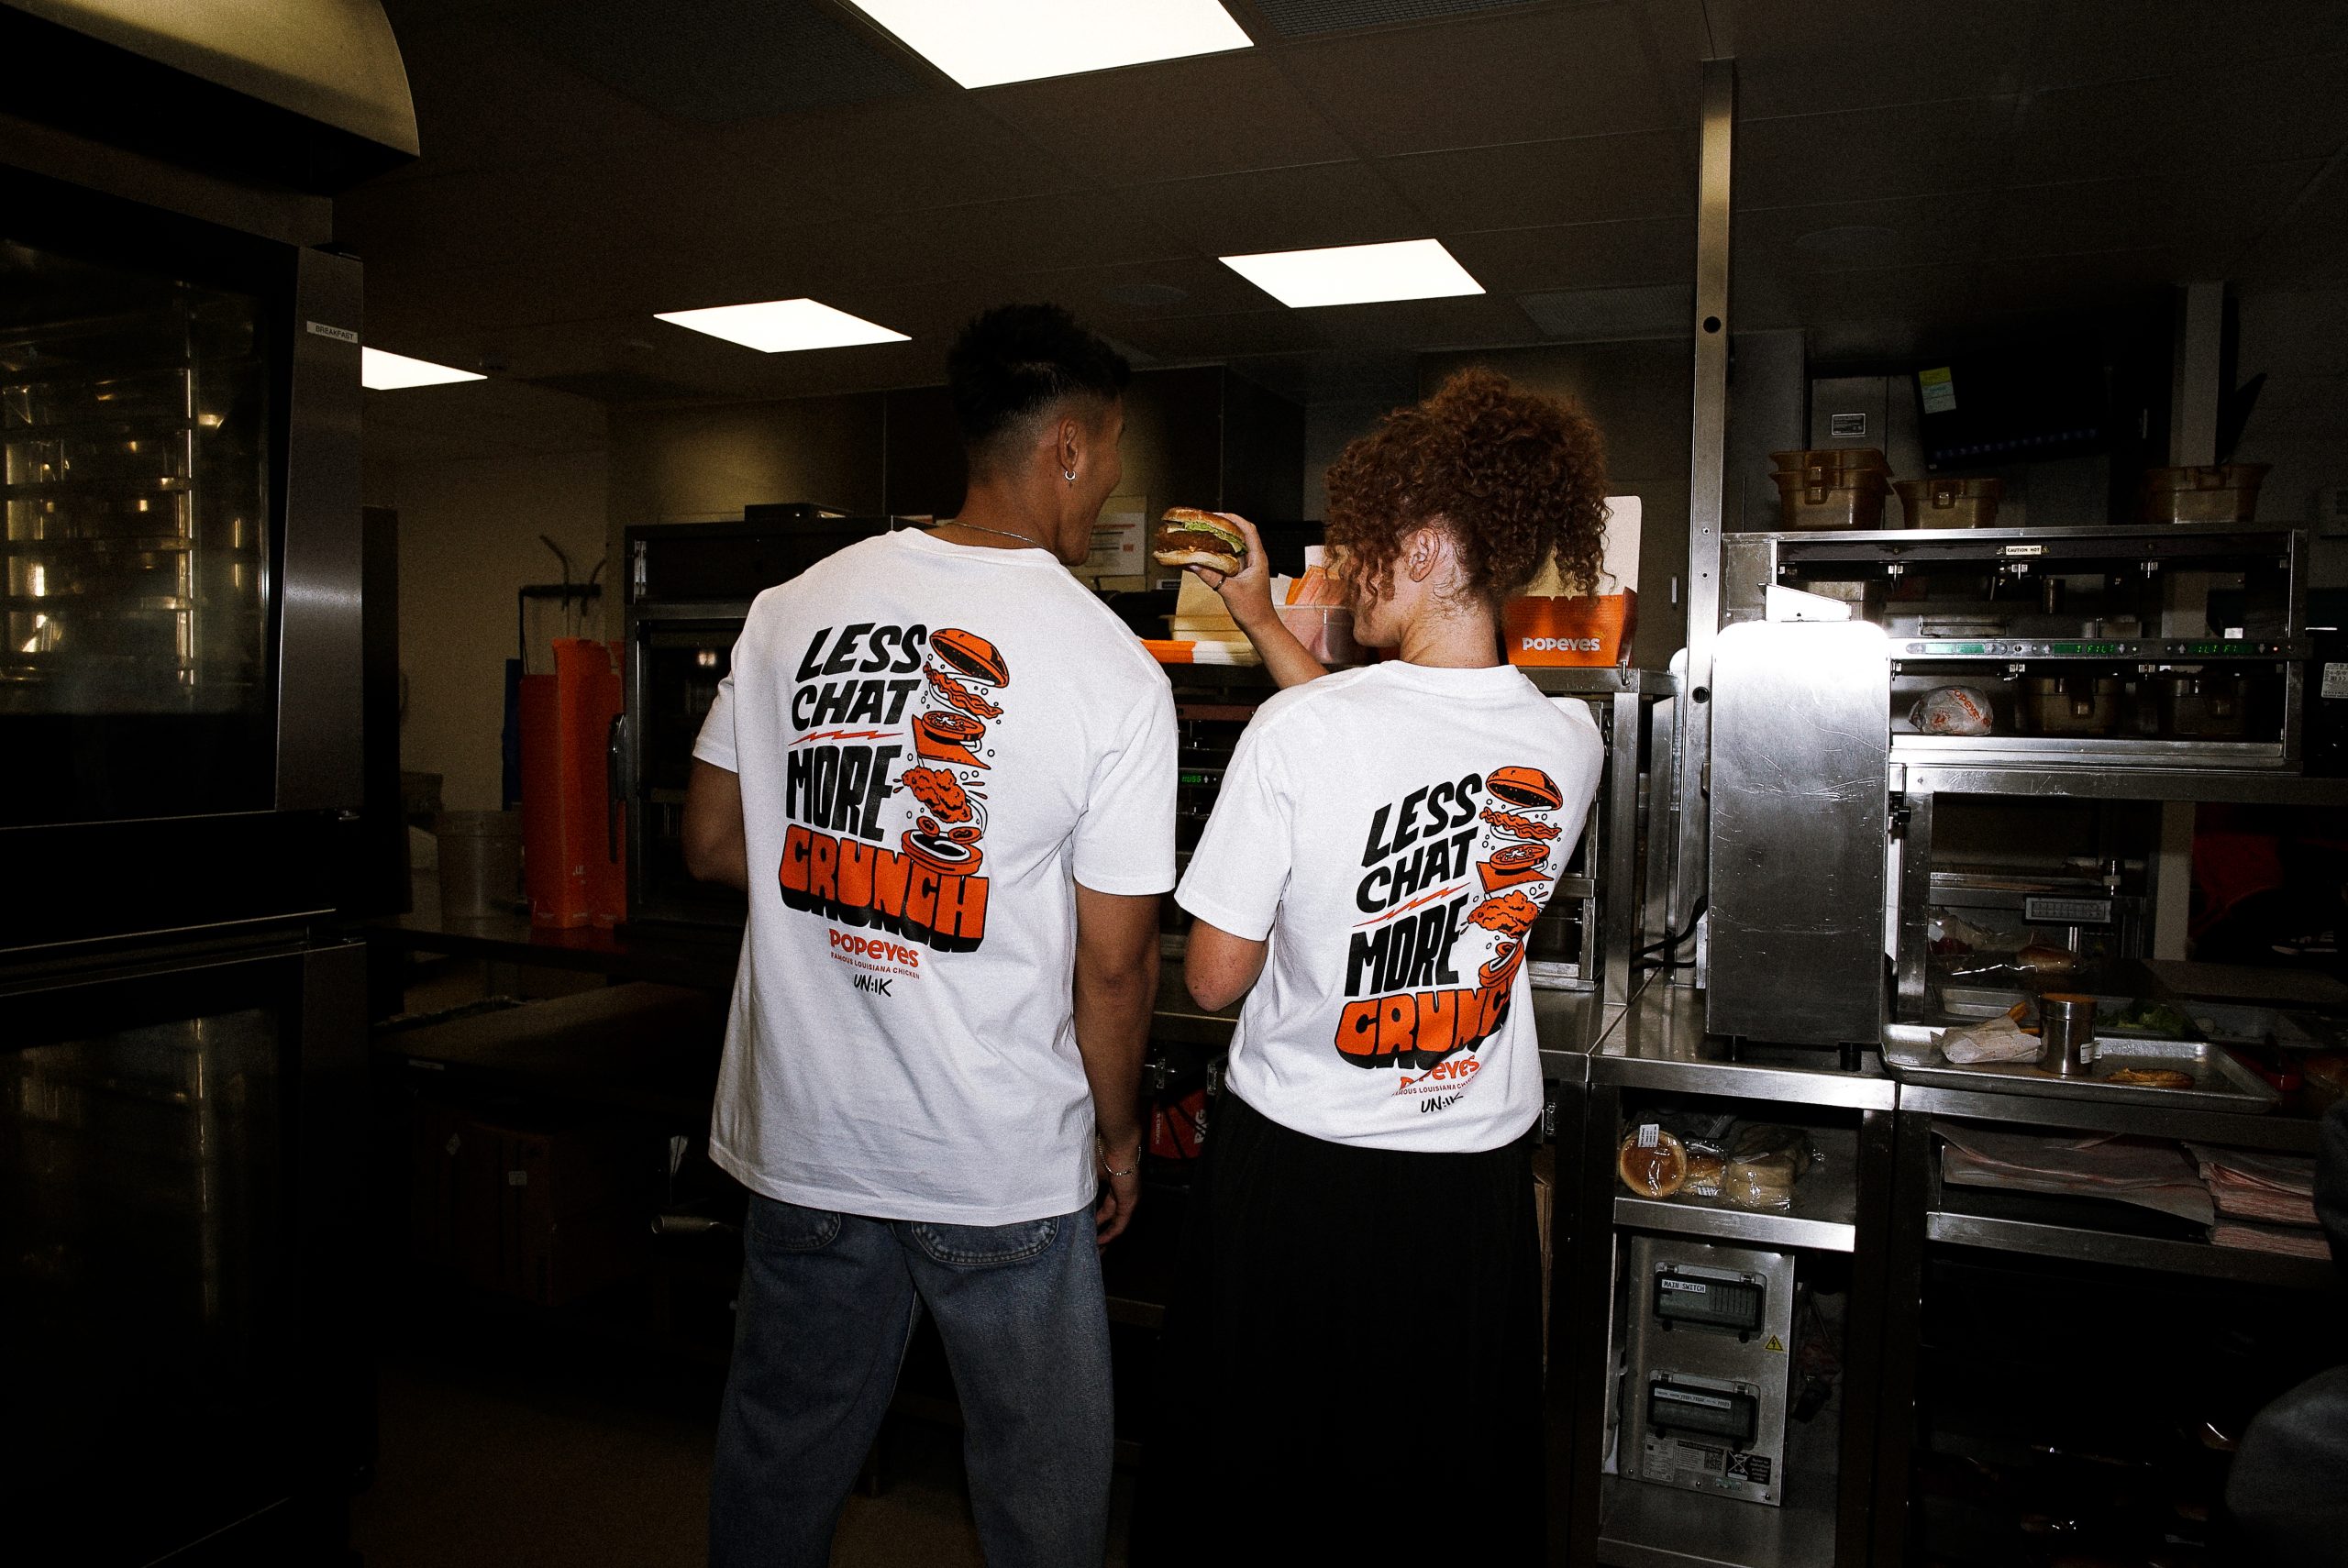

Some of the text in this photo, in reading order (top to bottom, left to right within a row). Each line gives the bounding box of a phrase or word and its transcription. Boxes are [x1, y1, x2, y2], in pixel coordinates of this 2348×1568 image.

[316, 325, 353, 340] BREAKFAST
[795, 623, 927, 683] LESS
[792, 679, 921, 731] CHAT
[786, 745, 903, 842] MORE
[1361, 773, 1482, 868] LESS
[778, 823, 990, 953] CRUNCH
[1357, 826, 1478, 913] CHAT
[831, 952, 920, 979] FAMOUS LOUISIANA CHICKEN
[1345, 892, 1469, 997] MORE
[854, 974, 892, 998] UN:IK
[1335, 984, 1512, 1069] CRUNC
[1419, 1084, 1456, 1093] LOUISIANA
[1664, 1281, 1705, 1292] MAIN SWITCH
